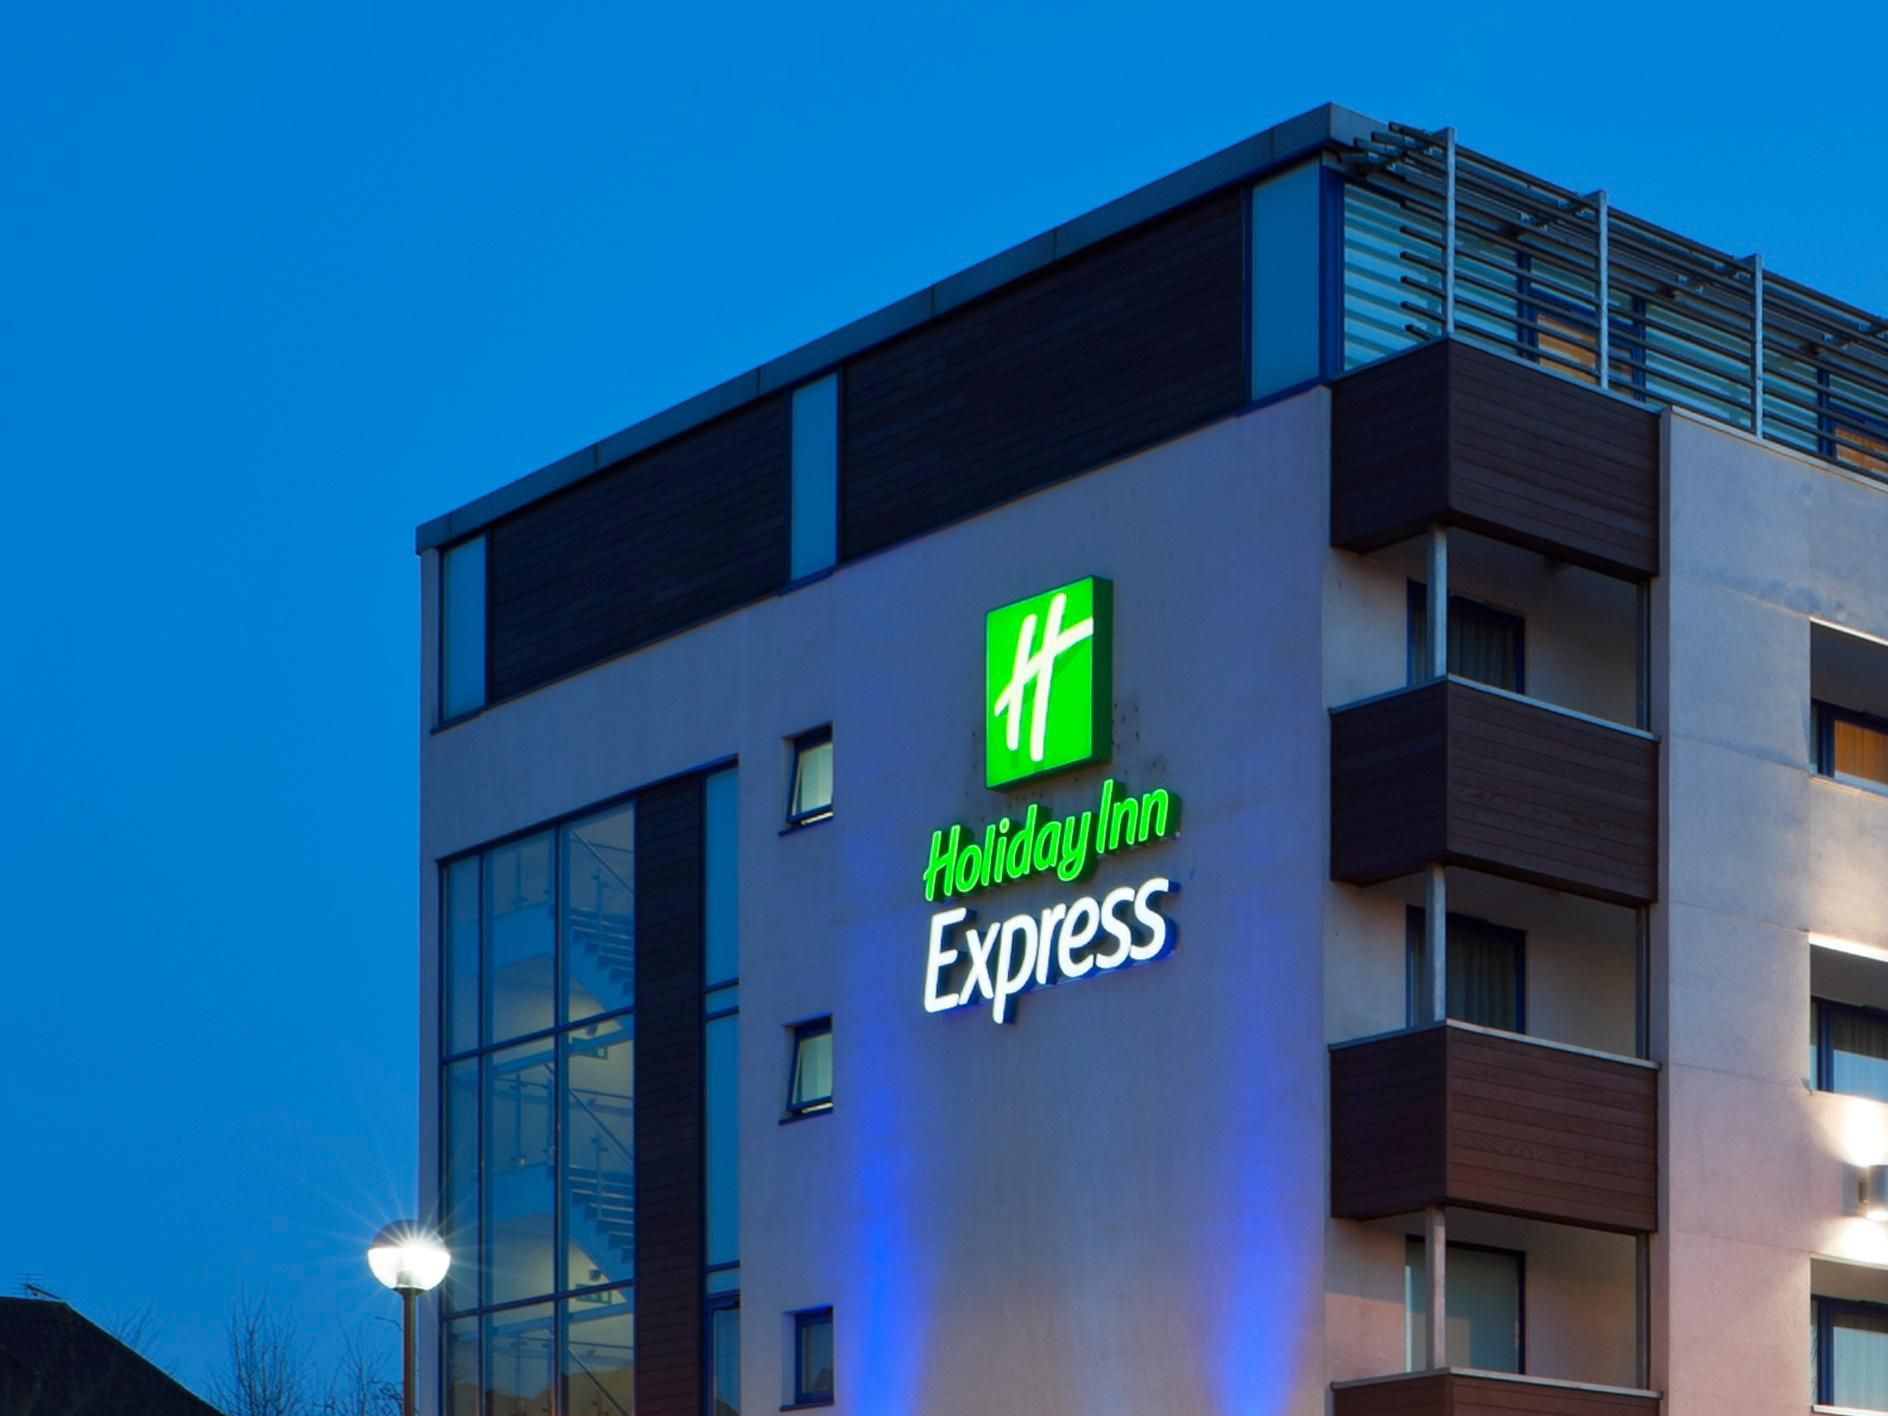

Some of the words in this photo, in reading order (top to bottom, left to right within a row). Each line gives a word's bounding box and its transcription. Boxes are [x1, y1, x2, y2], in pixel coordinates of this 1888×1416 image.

[994, 592, 1094, 762] H
[923, 804, 1090, 902] Holiday
[1096, 778, 1169, 854] Inn
[923, 877, 1170, 1024] Express
